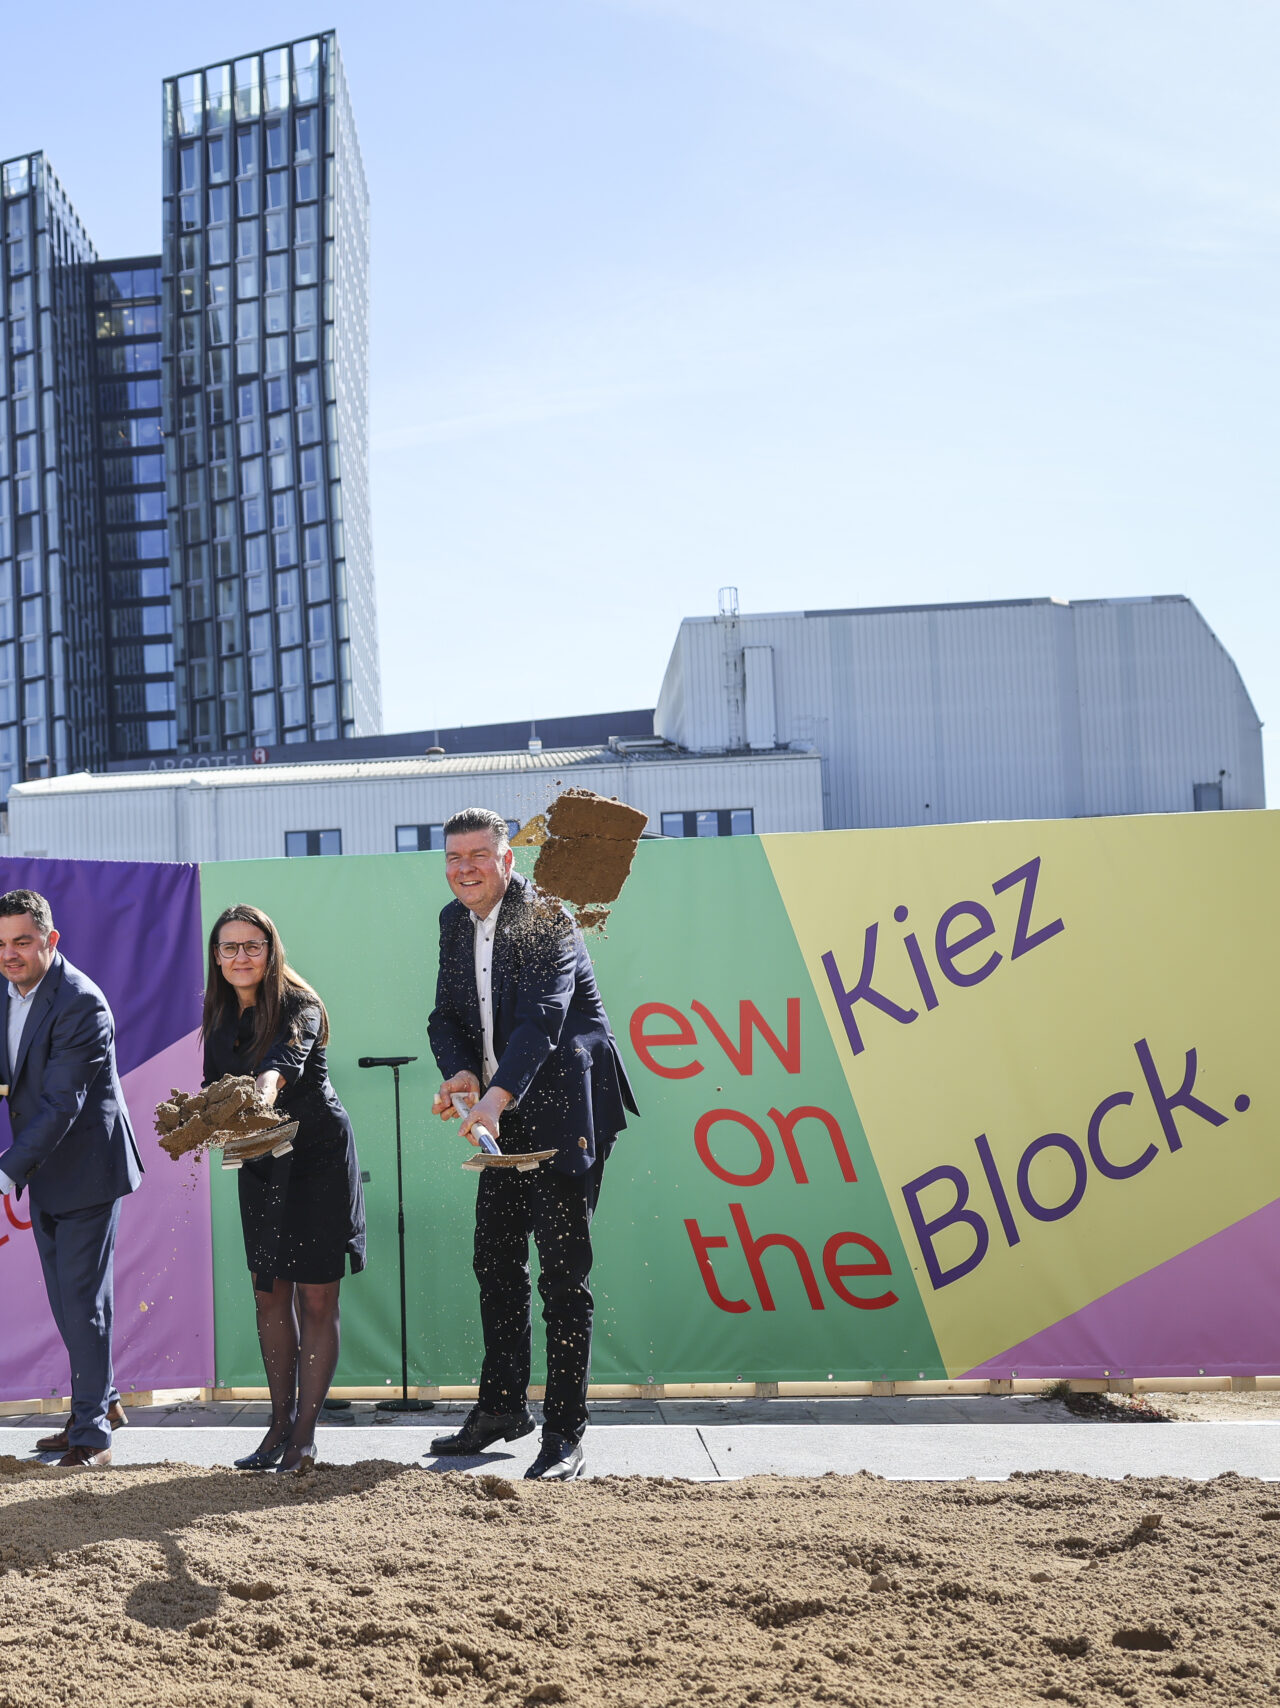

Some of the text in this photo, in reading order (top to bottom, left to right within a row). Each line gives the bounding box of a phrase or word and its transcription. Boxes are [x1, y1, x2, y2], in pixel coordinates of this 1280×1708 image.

[821, 856, 1065, 1056] Kiez
[693, 1105, 858, 1187] on
[901, 1038, 1251, 1291] Block.
[684, 1204, 900, 1314] the
